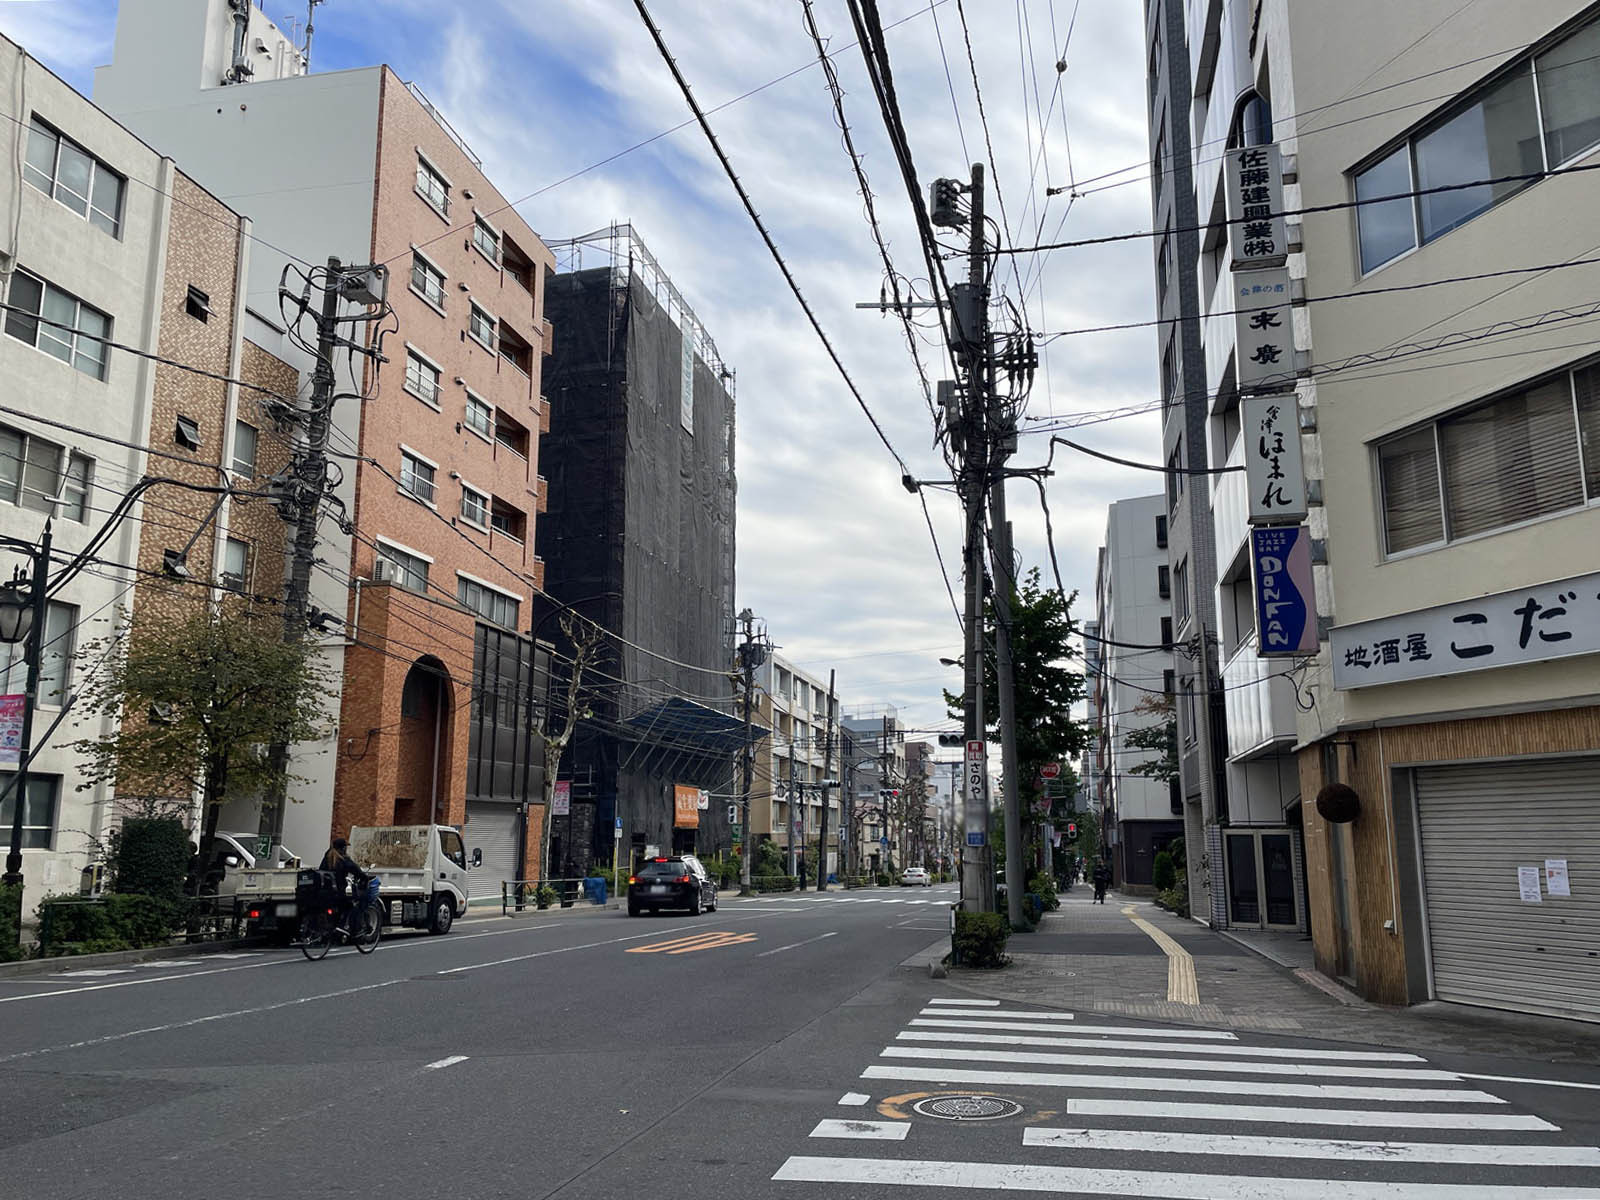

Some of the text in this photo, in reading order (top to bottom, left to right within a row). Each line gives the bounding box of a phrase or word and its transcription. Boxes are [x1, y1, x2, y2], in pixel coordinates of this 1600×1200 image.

[1344, 591, 1600, 669] 地酒屋 こだ
[970, 762, 981, 800] さのや
